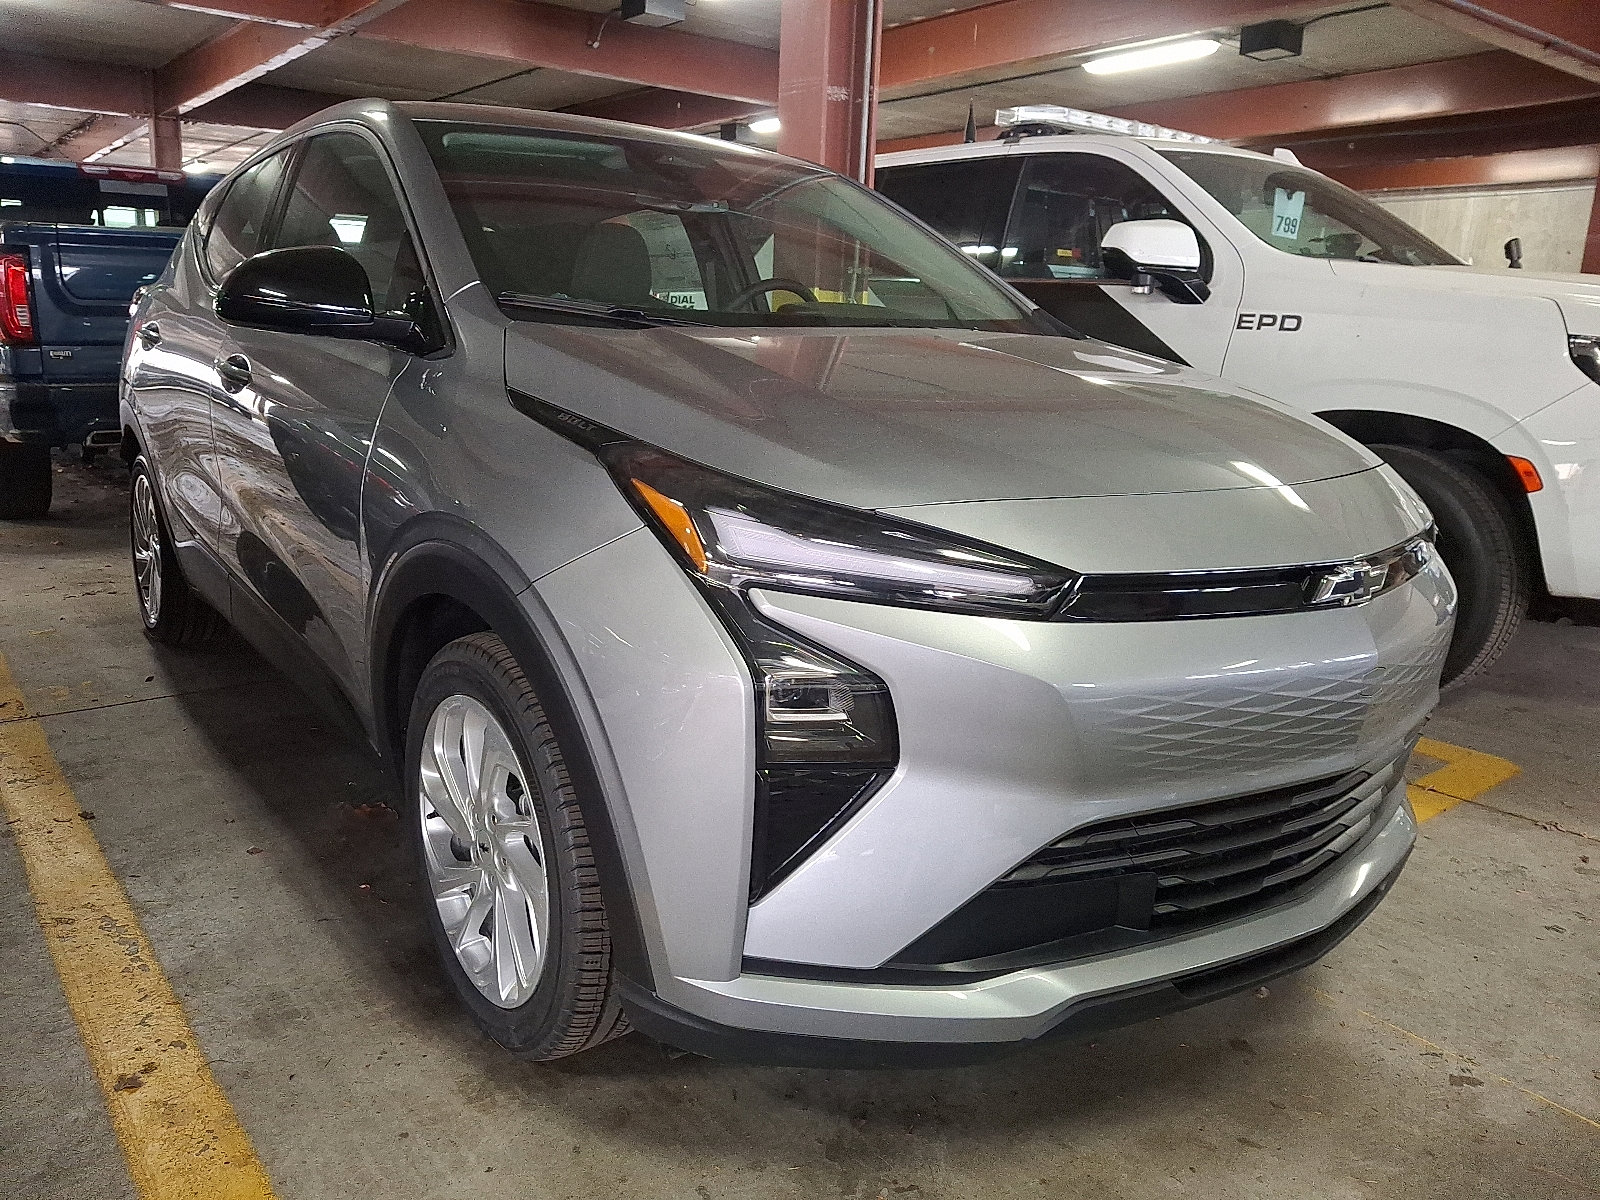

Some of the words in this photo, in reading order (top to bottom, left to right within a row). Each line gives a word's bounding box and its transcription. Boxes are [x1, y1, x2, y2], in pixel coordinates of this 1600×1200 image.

[1275, 215, 1298, 235] 799
[670, 295, 695, 304] DIAL
[1236, 313, 1303, 332] EPD
